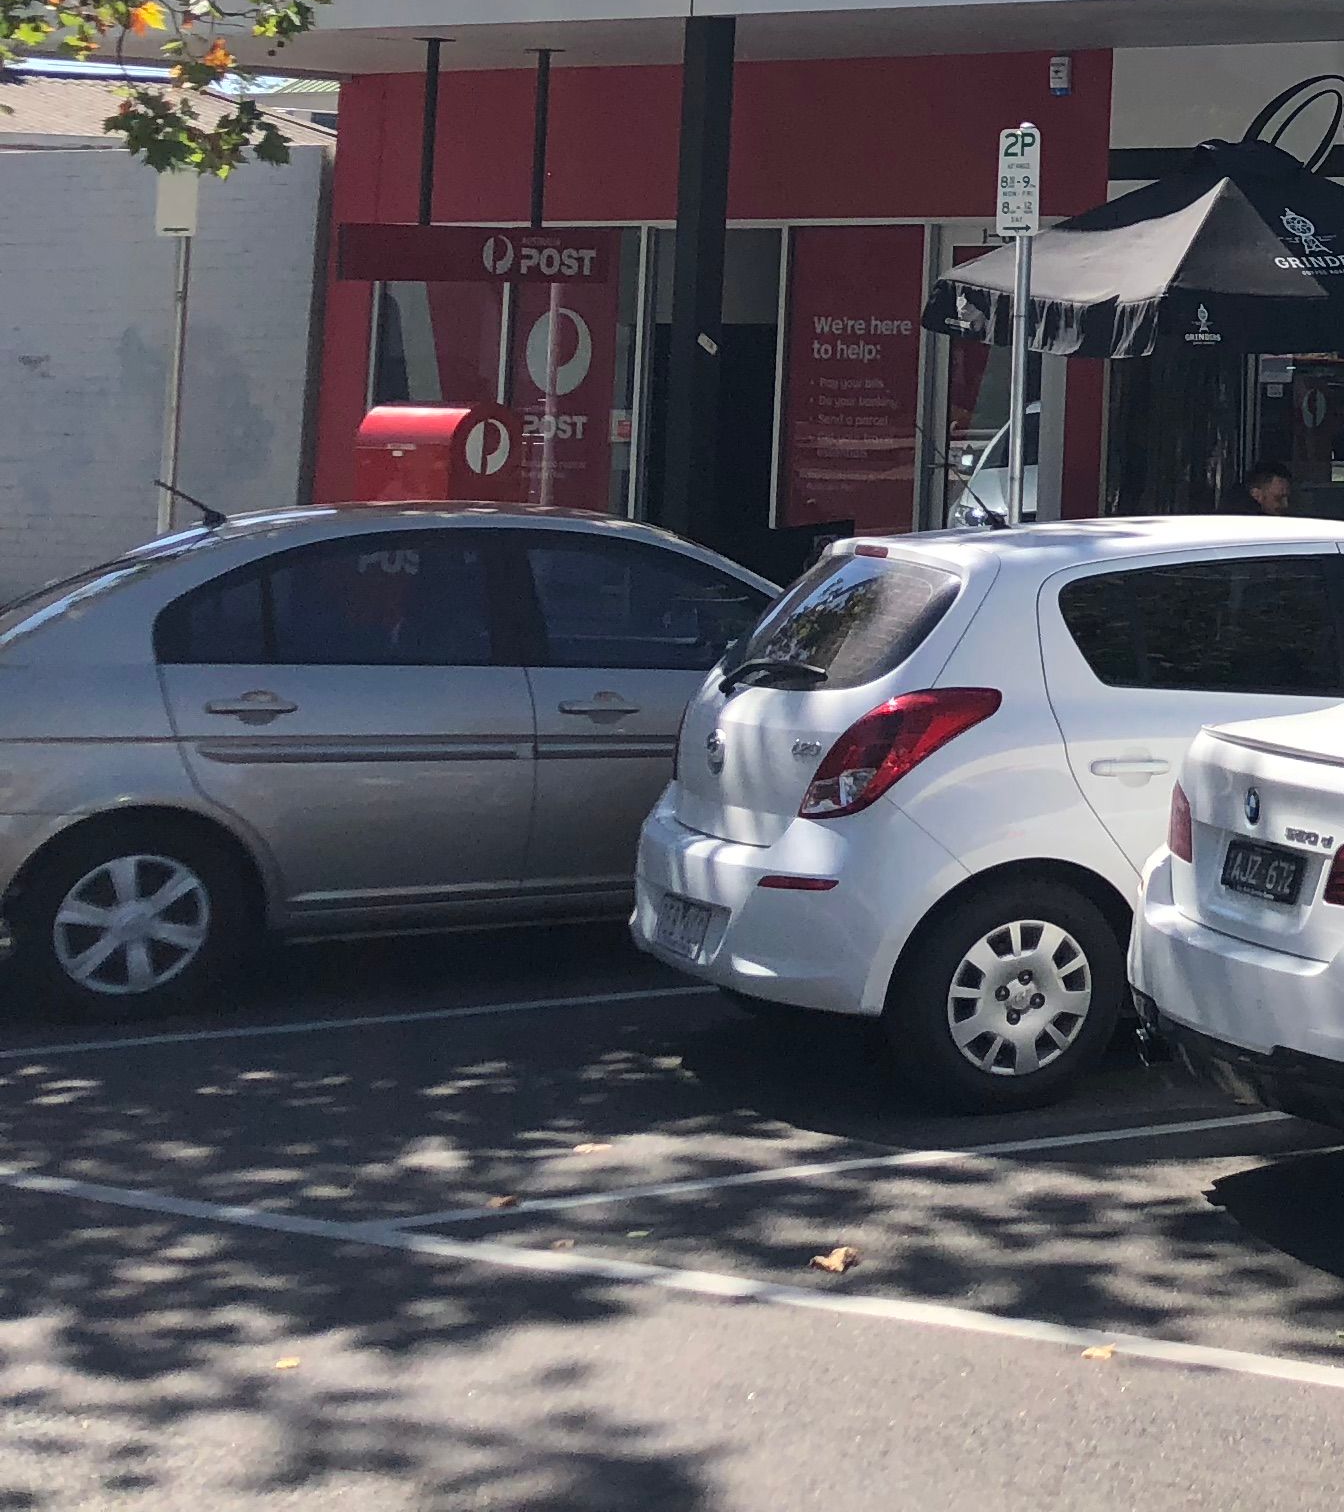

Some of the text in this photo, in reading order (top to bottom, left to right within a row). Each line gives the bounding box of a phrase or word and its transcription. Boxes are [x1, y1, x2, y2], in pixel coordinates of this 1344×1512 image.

[1003, 132, 1036, 157] 2P
[520, 247, 597, 276] POST
[813, 316, 912, 336] We're here
[812, 340, 881, 364] to help:
[523, 414, 589, 439] POST
